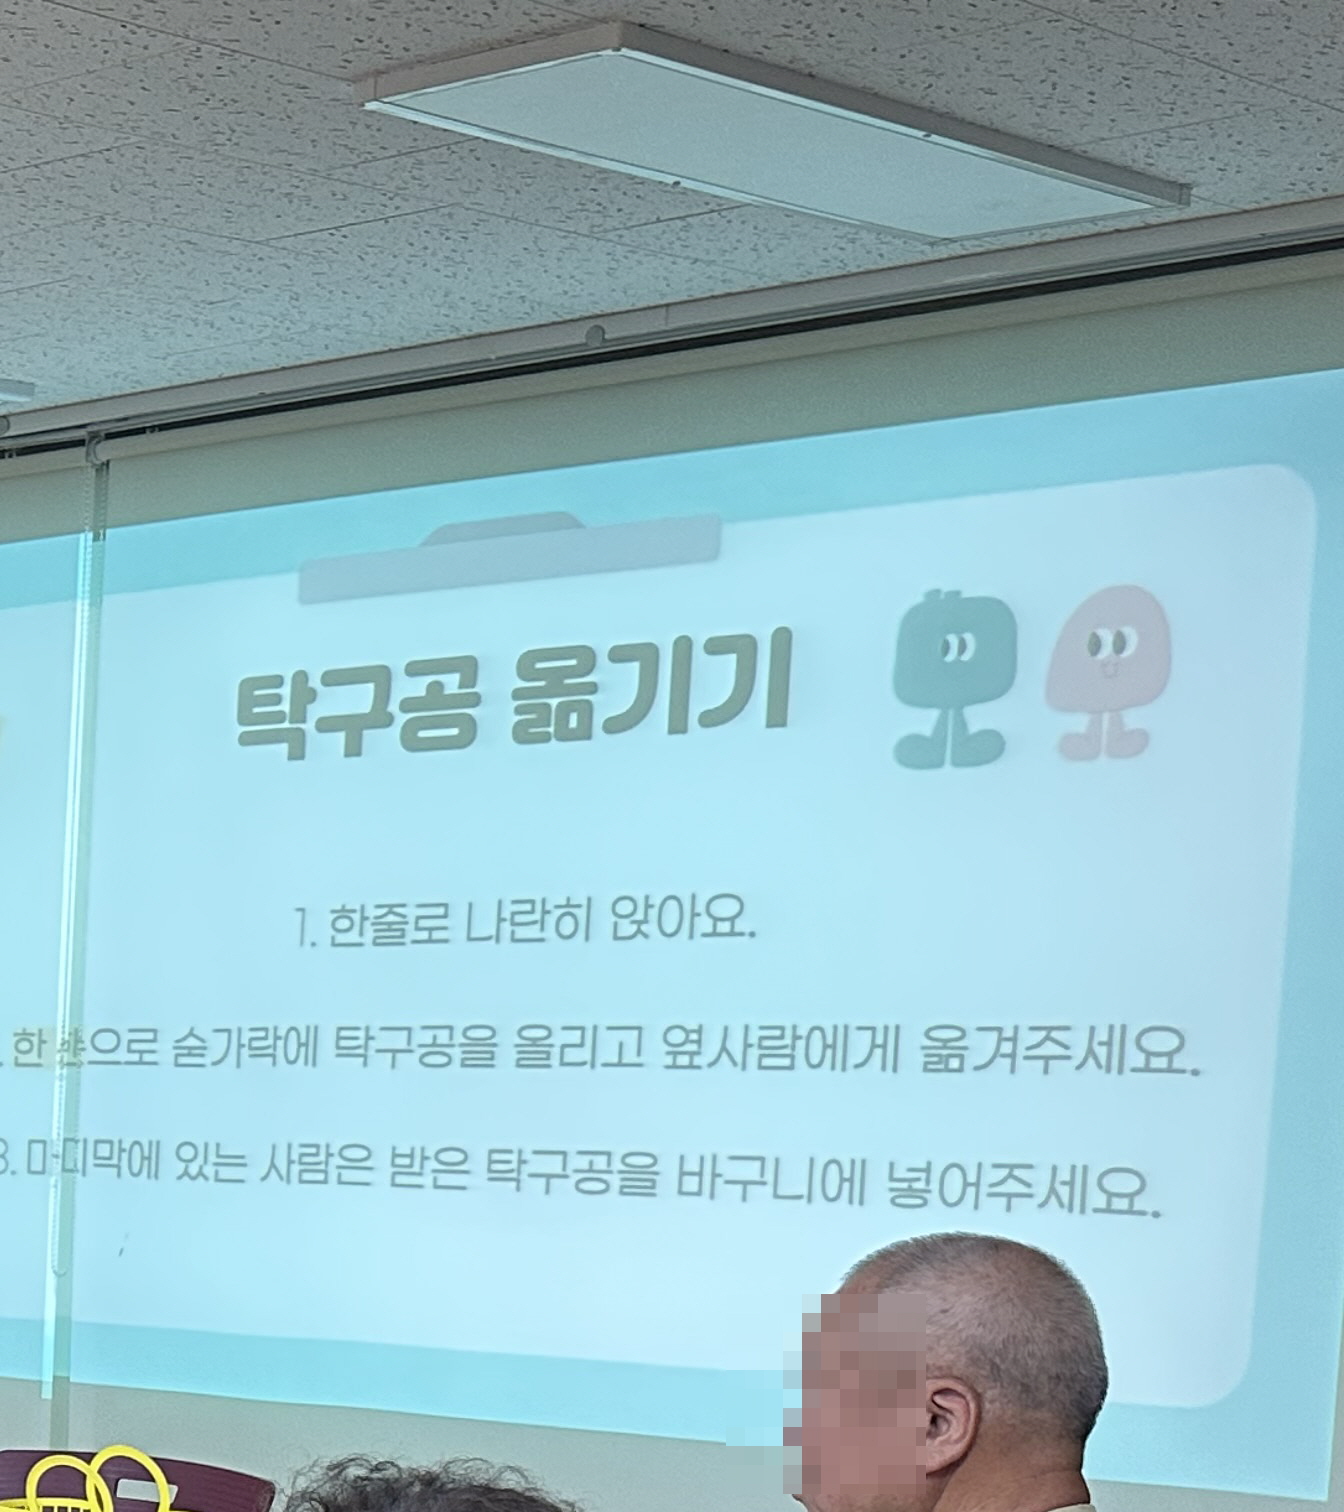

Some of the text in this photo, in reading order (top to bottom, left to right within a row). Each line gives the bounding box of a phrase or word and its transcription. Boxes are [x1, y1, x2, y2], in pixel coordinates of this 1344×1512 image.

[236, 626, 794, 762] 탁구공 옮기기
[293, 891, 757, 948] 1. 한줄로 나란히 앉아요.
[11, 1027, 48, 1069] 한
[171, 1025, 319, 1069] 숟가락에
[334, 1023, 499, 1070] 탁구공을
[513, 1023, 646, 1071] 올리고
[662, 1022, 902, 1074] 옆사람에게
[919, 1022, 1201, 1077] 옮겨주세요.
[174, 1140, 248, 1184] 있는
[259, 1141, 375, 1187] 사람은
[389, 1143, 472, 1191] 받은
[486, 1147, 661, 1197] 탁구공을
[676, 1152, 867, 1208] 바구니에
[887, 1159, 1162, 1220] 넣어주세요.
